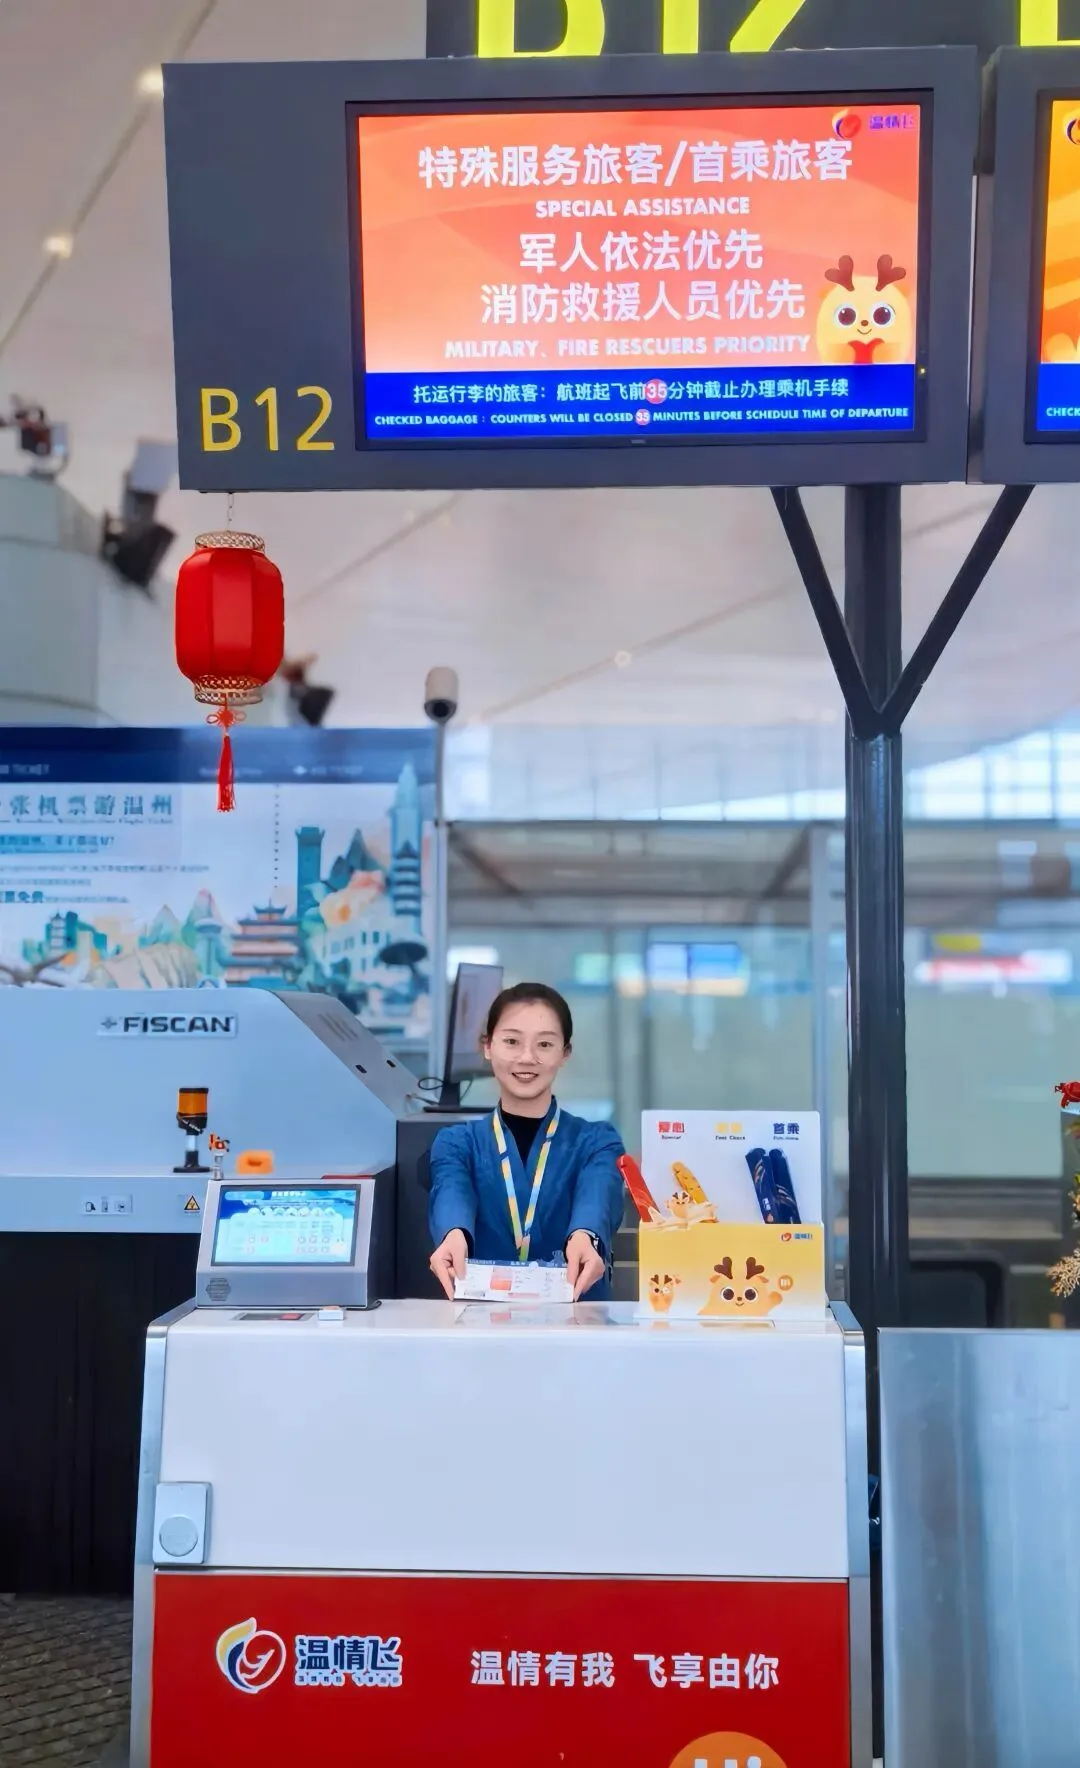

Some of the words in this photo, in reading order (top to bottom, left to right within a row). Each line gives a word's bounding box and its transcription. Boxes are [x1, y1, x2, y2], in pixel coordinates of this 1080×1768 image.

[418, 138, 853, 189] 特殊服务旅客/首乘旅客
[535, 198, 617, 218] SPECIAL
[623, 196, 750, 216] ASSISTANCE
[519, 228, 764, 274] 军人依法优先
[480, 279, 805, 325] 消防救援人员优先
[558, 338, 600, 357] FIRE
[607, 336, 707, 356] RESCUERS
[714, 334, 811, 354] PRIORITY
[201, 385, 335, 451] B12
[374, 415, 423, 426] CHECKED
[425, 414, 478, 425] BAGGAGE
[490, 413, 547, 425] COUNTERS
[549, 413, 575, 424] WILL
[577, 413, 590, 423] BE
[593, 412, 633, 423] CLOSED
[636, 411, 649, 422] 35
[653, 410, 700, 422] MINUTES
[703, 410, 743, 421] BEFORE
[746, 409, 799, 420] SCHEDULE
[802, 408, 827, 419] TIME
[830, 408, 845, 418] OF
[848, 407, 909, 418] DEPARTURE
[123, 1016, 232, 1032] FISCAN
[297, 1637, 401, 1672] 温情飞
[470, 1651, 616, 1688] 温情有我
[633, 1653, 779, 1690] 飞享由你
